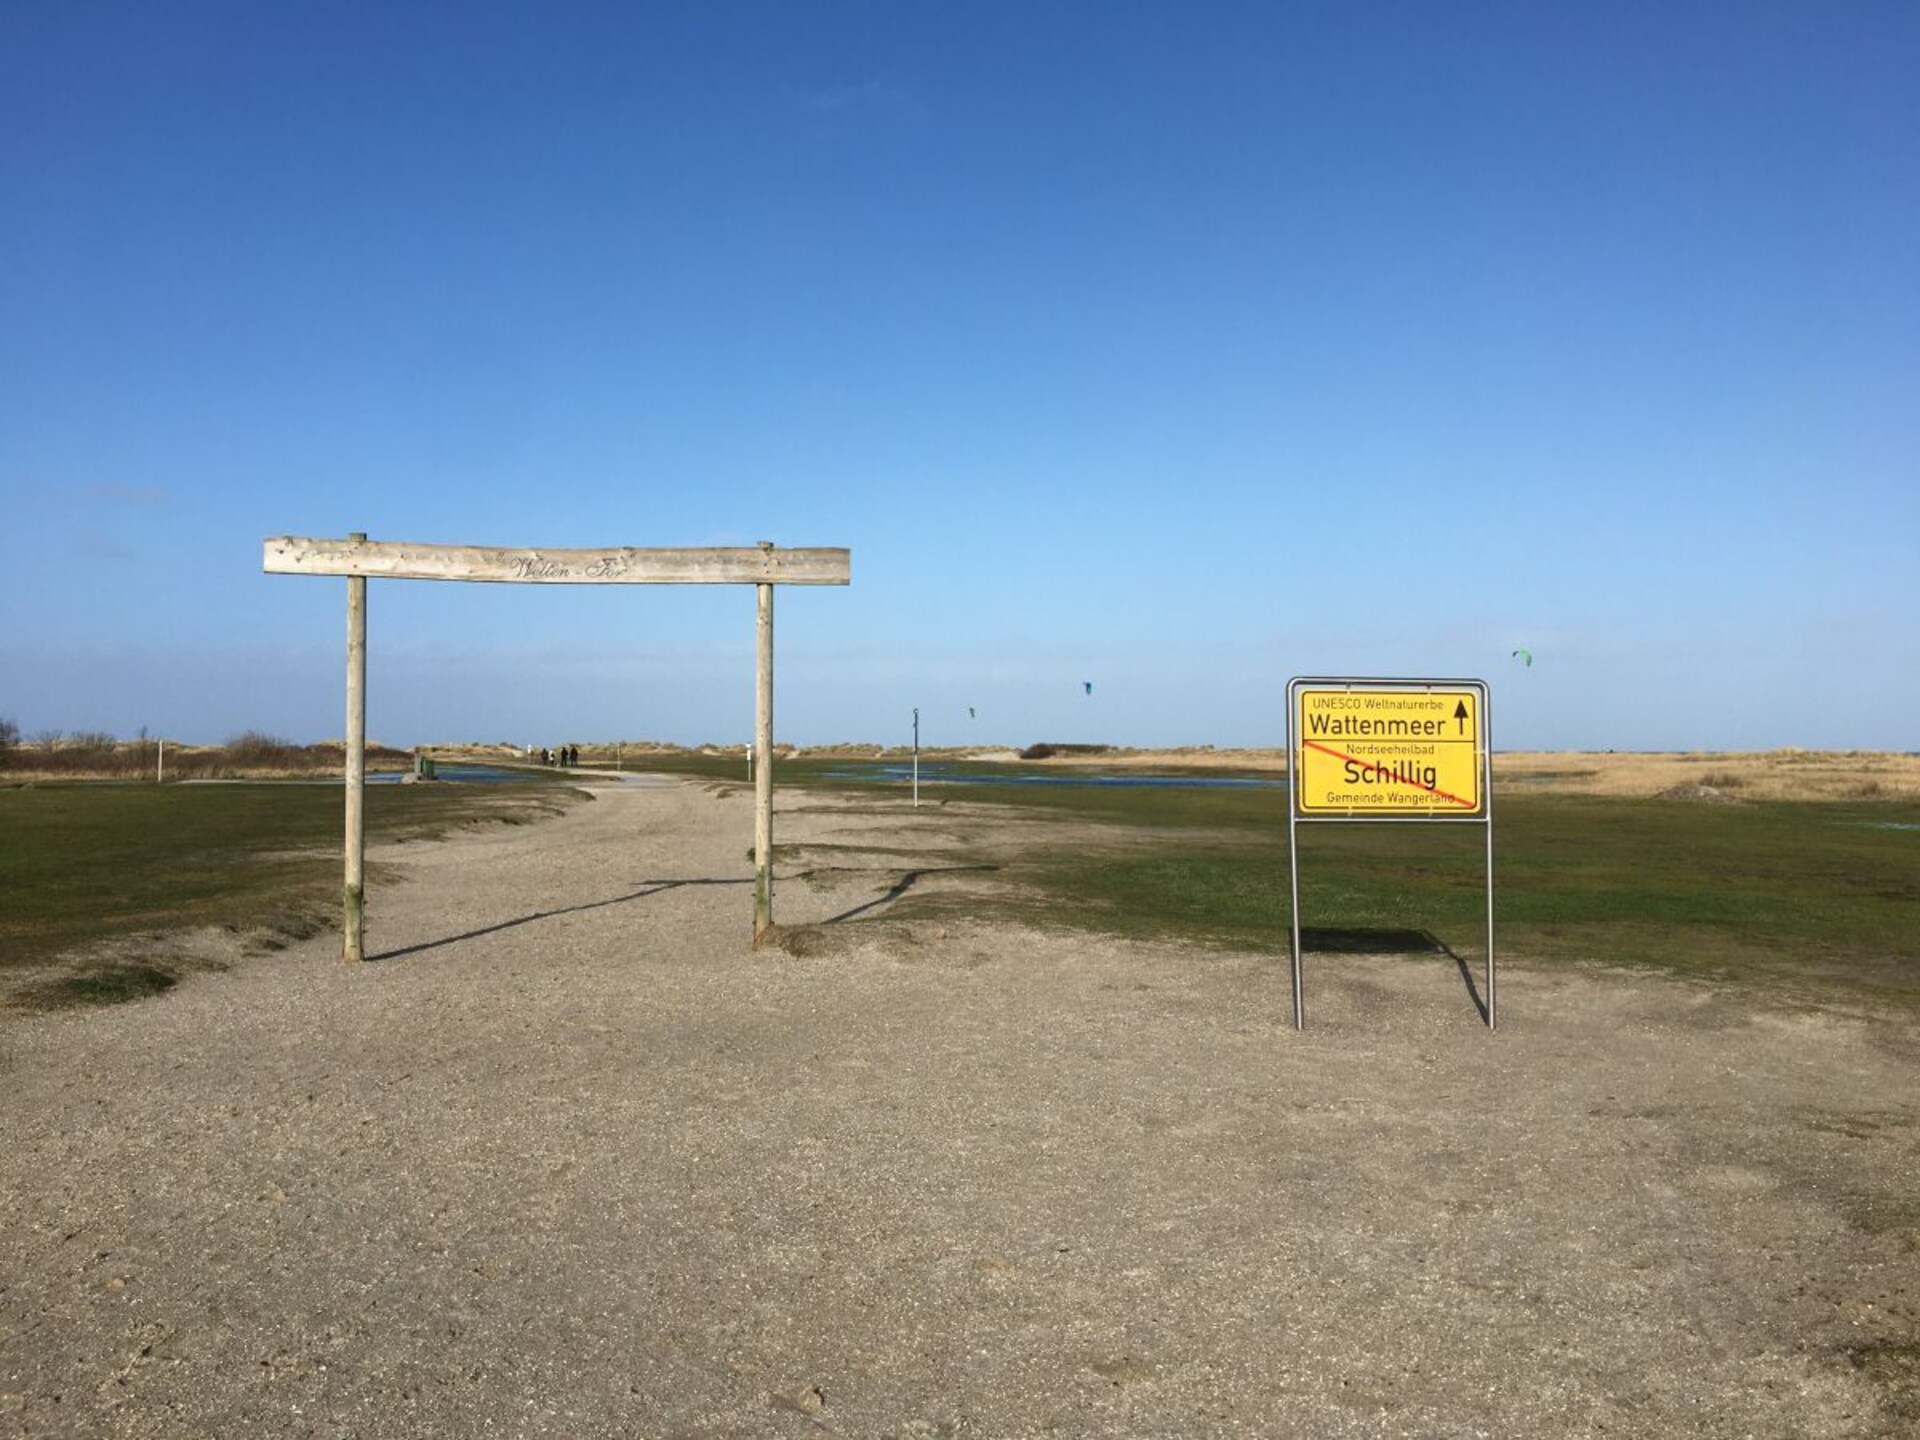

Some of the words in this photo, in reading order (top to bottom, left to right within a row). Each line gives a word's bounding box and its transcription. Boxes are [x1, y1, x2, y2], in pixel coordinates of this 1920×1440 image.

[1312, 697, 1361, 709] UNESCO
[1364, 698, 1444, 710] Weltnaturerbe
[1309, 713, 1446, 735] Wattenmeer
[1346, 744, 1435, 755] Nordseeheilbad
[1343, 760, 1436, 790] Schillig
[1326, 791, 1385, 803] Gemeinde
